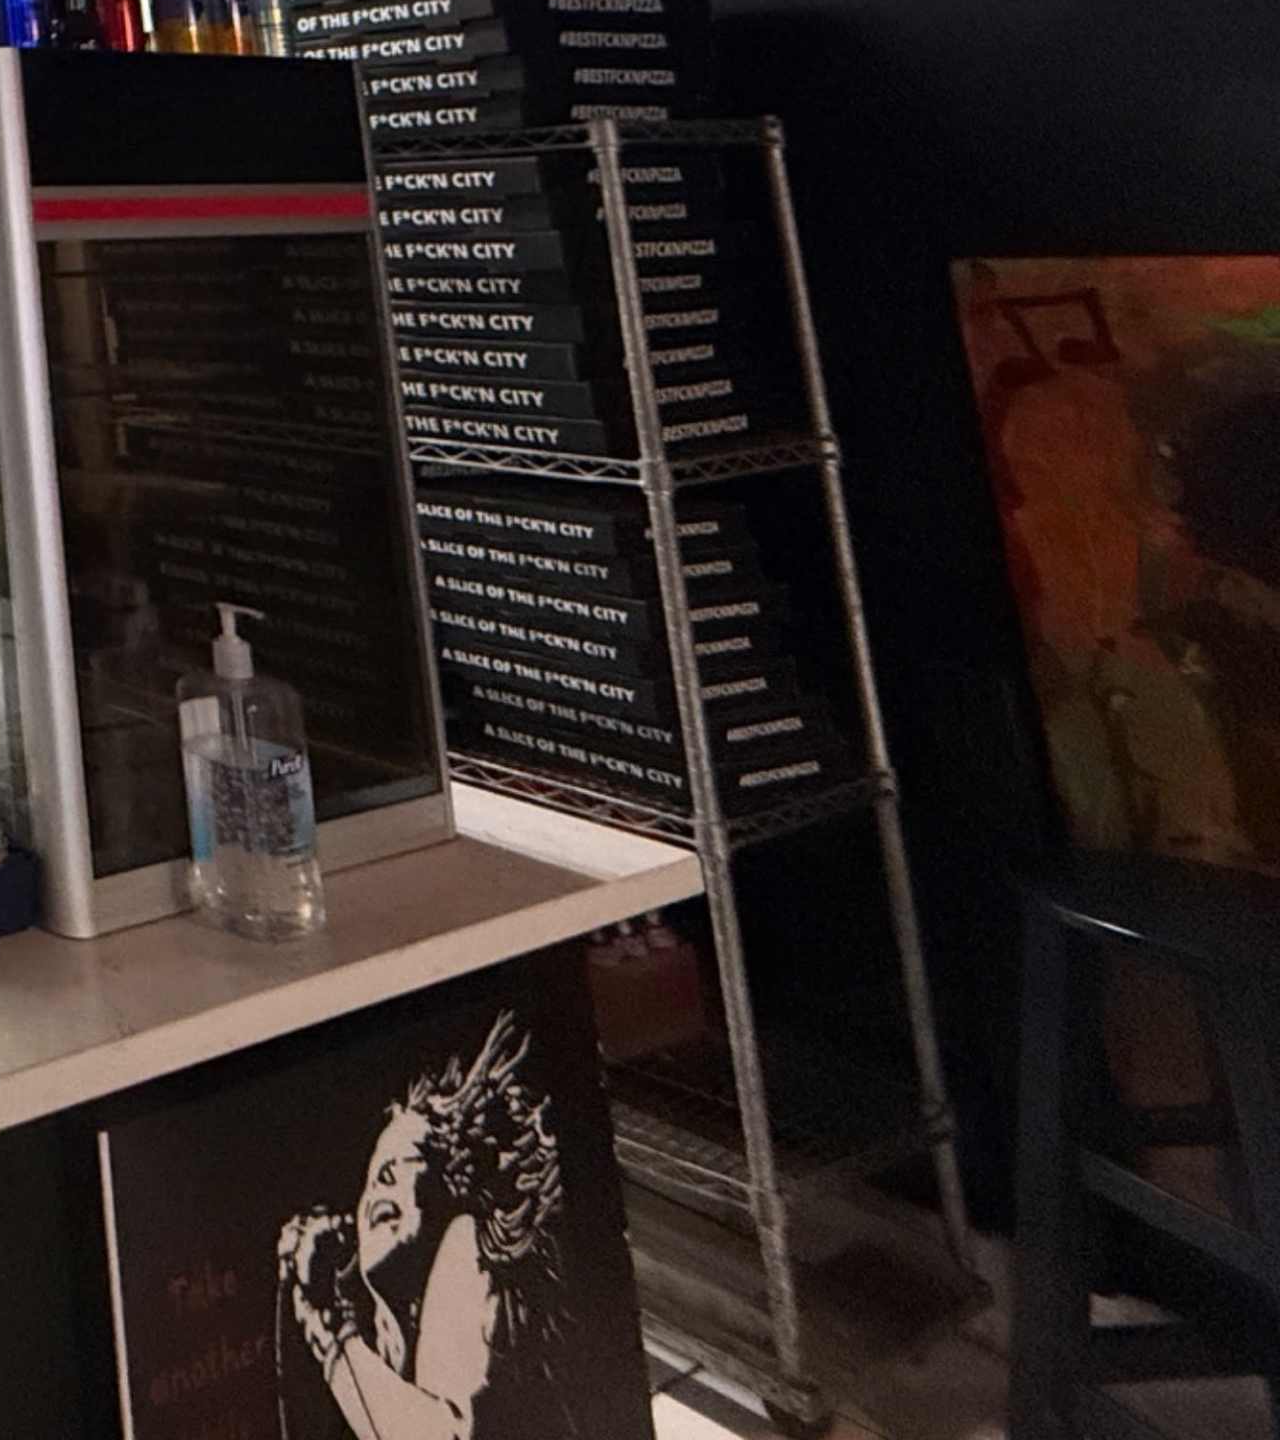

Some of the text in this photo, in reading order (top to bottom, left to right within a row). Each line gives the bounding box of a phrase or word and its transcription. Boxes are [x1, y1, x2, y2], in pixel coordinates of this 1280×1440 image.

[297, 17, 317, 33] OF
[320, 10, 350, 30] THE
[424, 32, 465, 54] CITY
[436, 70, 478, 89] CITY
[436, 106, 478, 126] CITY
[452, 170, 496, 189] CITY
[460, 207, 504, 225] CITY
[472, 242, 516, 260] CITY
[476, 278, 521, 295] CITY
[489, 314, 535, 332] CITY
[483, 351, 528, 369] CITY
[499, 389, 544, 409] CITY
[513, 427, 559, 445] CITY
[455, 507, 473, 522] OF
[475, 511, 502, 528] THE
[560, 521, 594, 540] CITY
[428, 539, 465, 558] SLICE
[467, 544, 485, 560] OF
[488, 549, 515, 566] THE
[573, 561, 609, 581] CITY
[435, 575, 445, 588] A
[447, 577, 484, 596] SLICE
[486, 584, 505, 600] OF
[508, 589, 535, 608] THE
[593, 605, 628, 625] CITY
[440, 611, 475, 632] SLICE
[478, 619, 496, 635] OF
[499, 623, 526, 642] THE
[583, 641, 617, 660] CITY
[441, 647, 452, 661] A
[454, 651, 491, 670] SLICE
[493, 659, 511, 674] OF
[514, 664, 541, 683] THE
[600, 682, 635, 703] CITY
[486, 689, 524, 709] SLICE
[527, 698, 545, 714] OF
[549, 703, 577, 723] THE
[637, 724, 673, 745] CITY
[497, 728, 535, 748] SLICE
[537, 738, 556, 754] OF
[559, 744, 587, 763] THE
[646, 767, 683, 790] CITY
